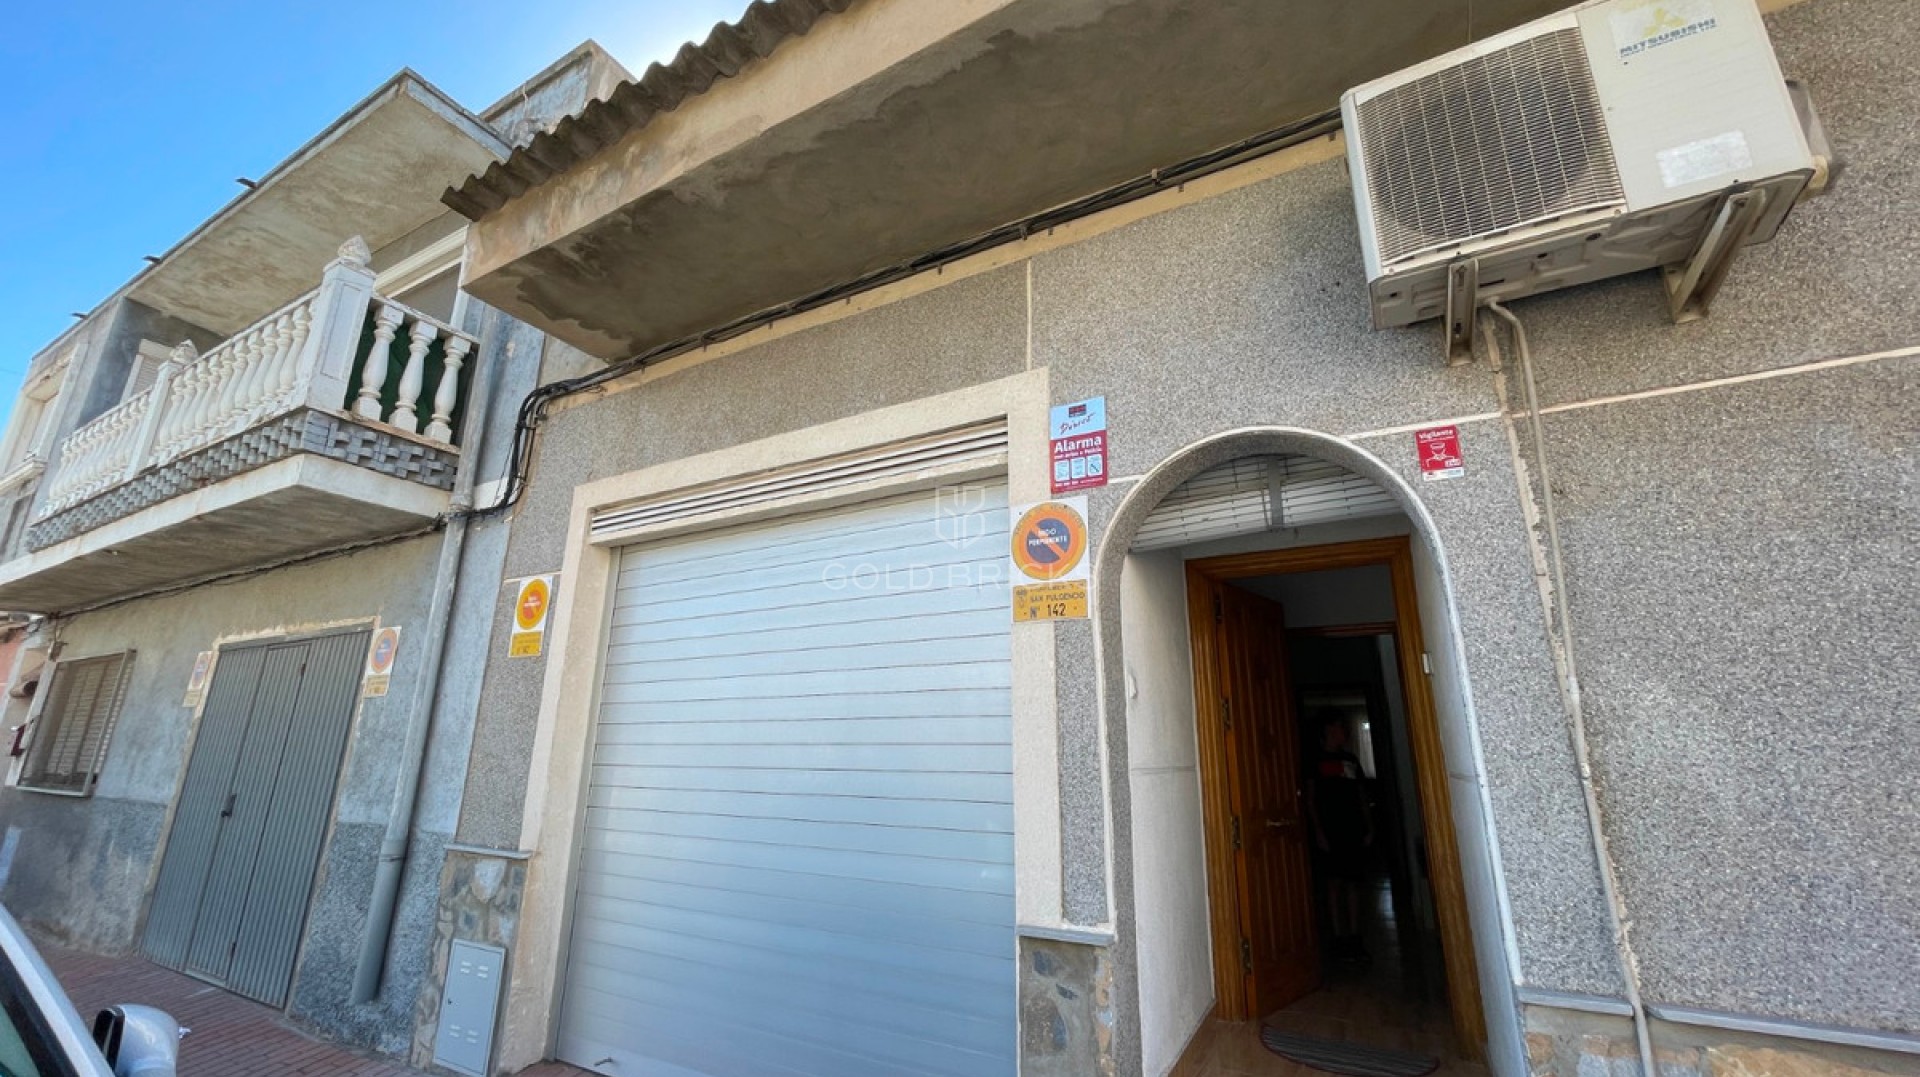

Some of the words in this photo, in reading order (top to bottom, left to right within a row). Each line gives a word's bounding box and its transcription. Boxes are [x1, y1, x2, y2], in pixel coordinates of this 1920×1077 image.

[1619, 18, 1716, 54] MITSUBISHI
[1054, 436, 1102, 453] Alarma
[1047, 603, 1066, 616] 142
